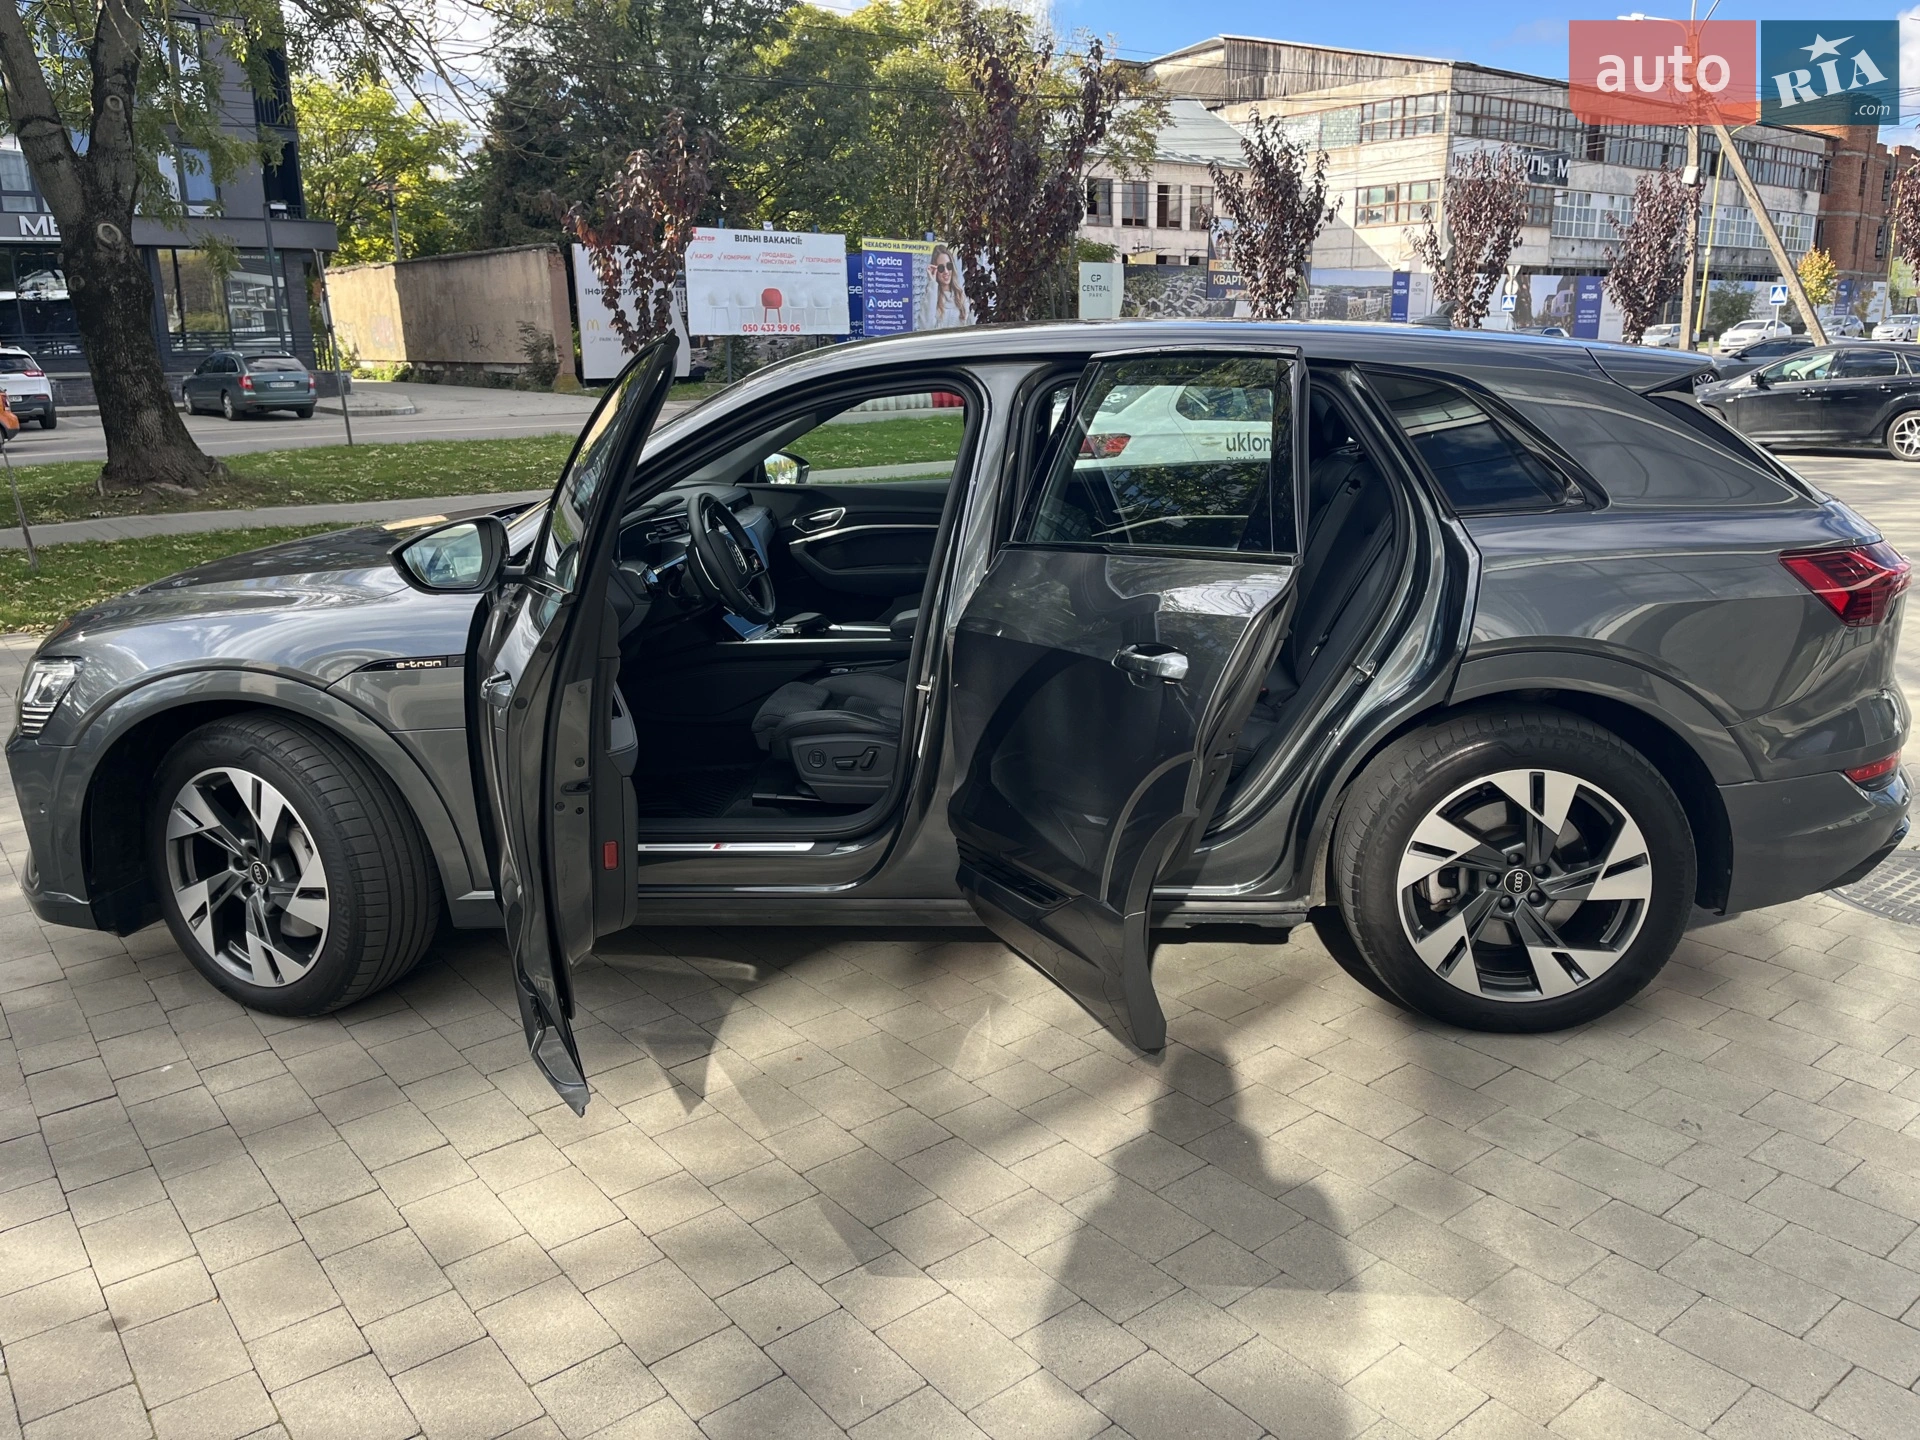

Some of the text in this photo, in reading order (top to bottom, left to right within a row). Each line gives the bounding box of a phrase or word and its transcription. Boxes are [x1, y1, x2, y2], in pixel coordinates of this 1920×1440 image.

[734, 234, 803, 245] ВІЛЬНІ ВАКАНСІЇ:
[864, 241, 892, 249] ЧЕКАЄМО
[877, 255, 902, 266] optica
[1213, 261, 1234, 269] ПРОД
[1091, 274, 1102, 283] CP
[1213, 274, 1242, 285] КВАРТ
[877, 298, 903, 309] optica
[742, 324, 801, 332] 050 432 99 06
[1226, 431, 1272, 451] uklon
[396, 660, 442, 669] e-tron
